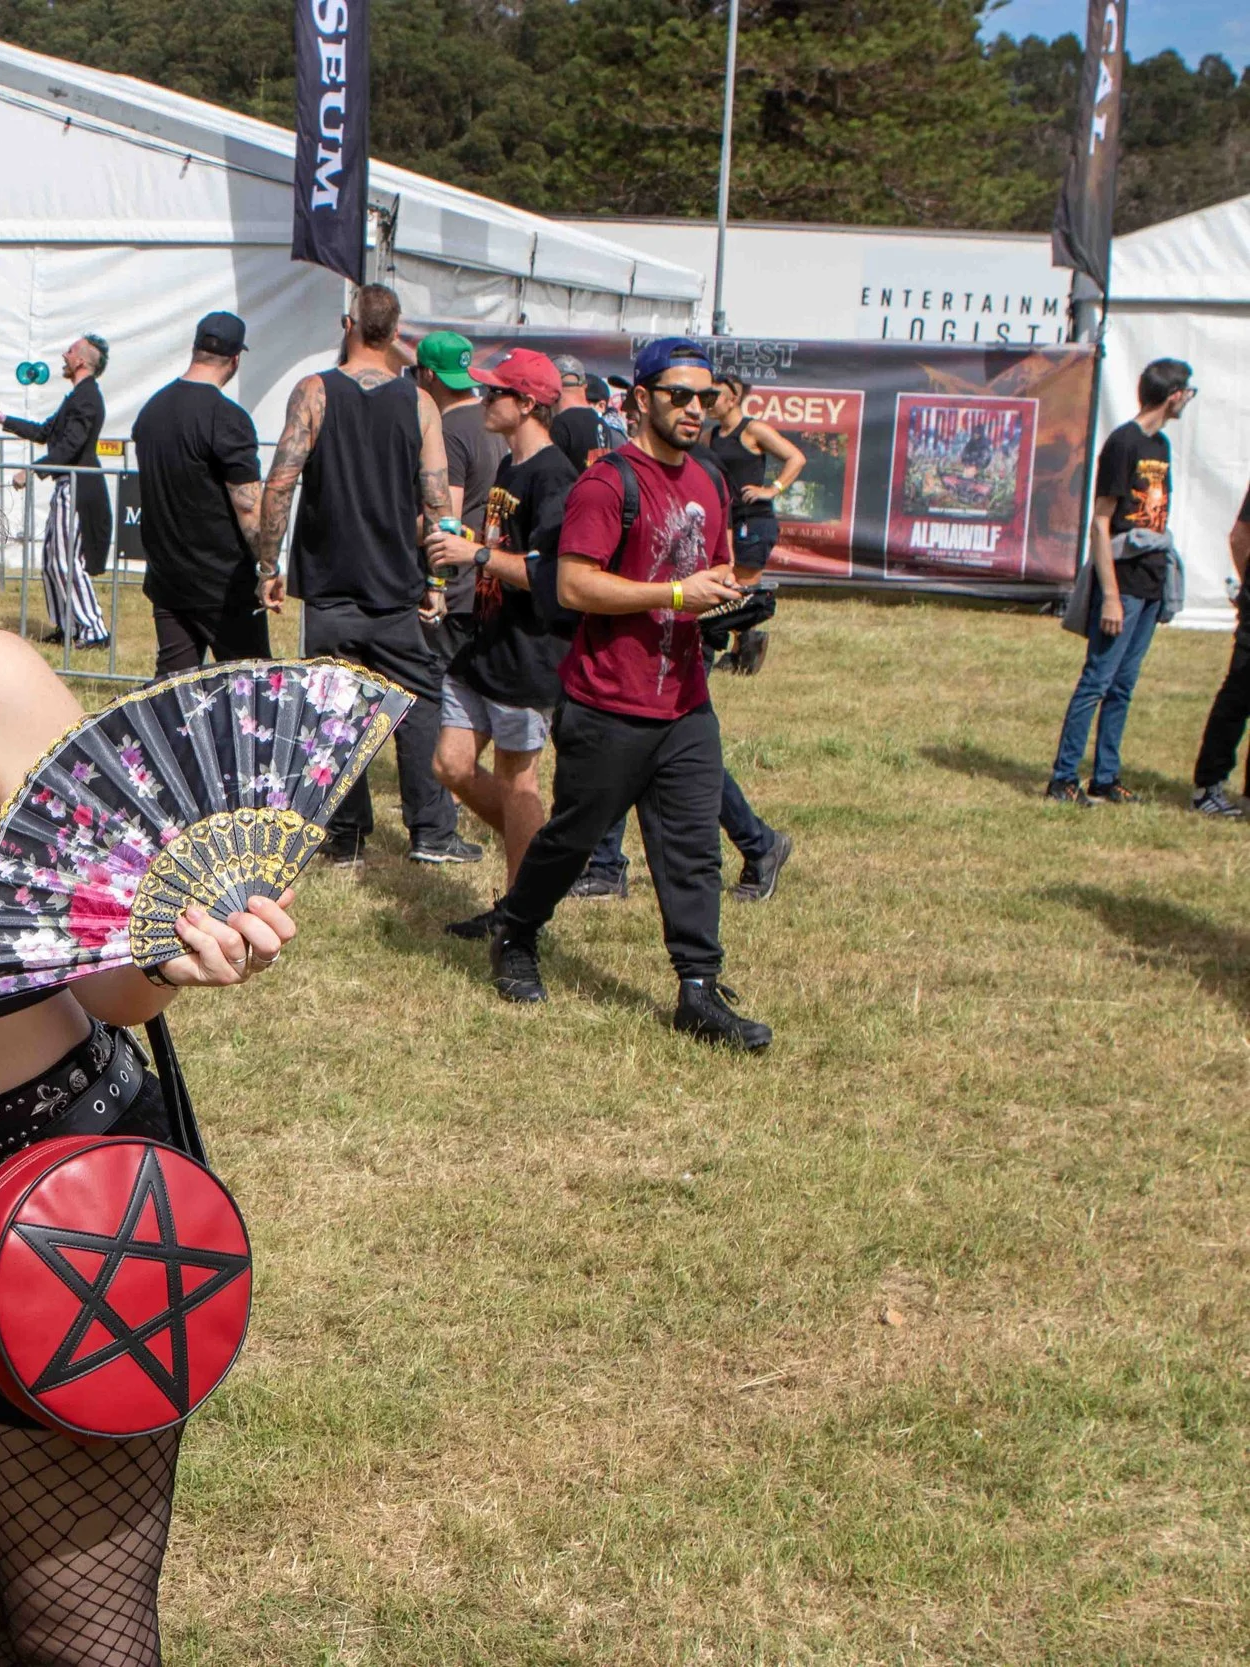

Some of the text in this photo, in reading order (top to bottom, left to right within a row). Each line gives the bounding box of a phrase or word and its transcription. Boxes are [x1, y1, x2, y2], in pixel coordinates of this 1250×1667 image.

[312, 0, 348, 211] SEUM
[861, 287, 1059, 316] ENTERTAINM
[881, 316, 1063, 343] LOGISTI
[741, 395, 846, 425] CASEY
